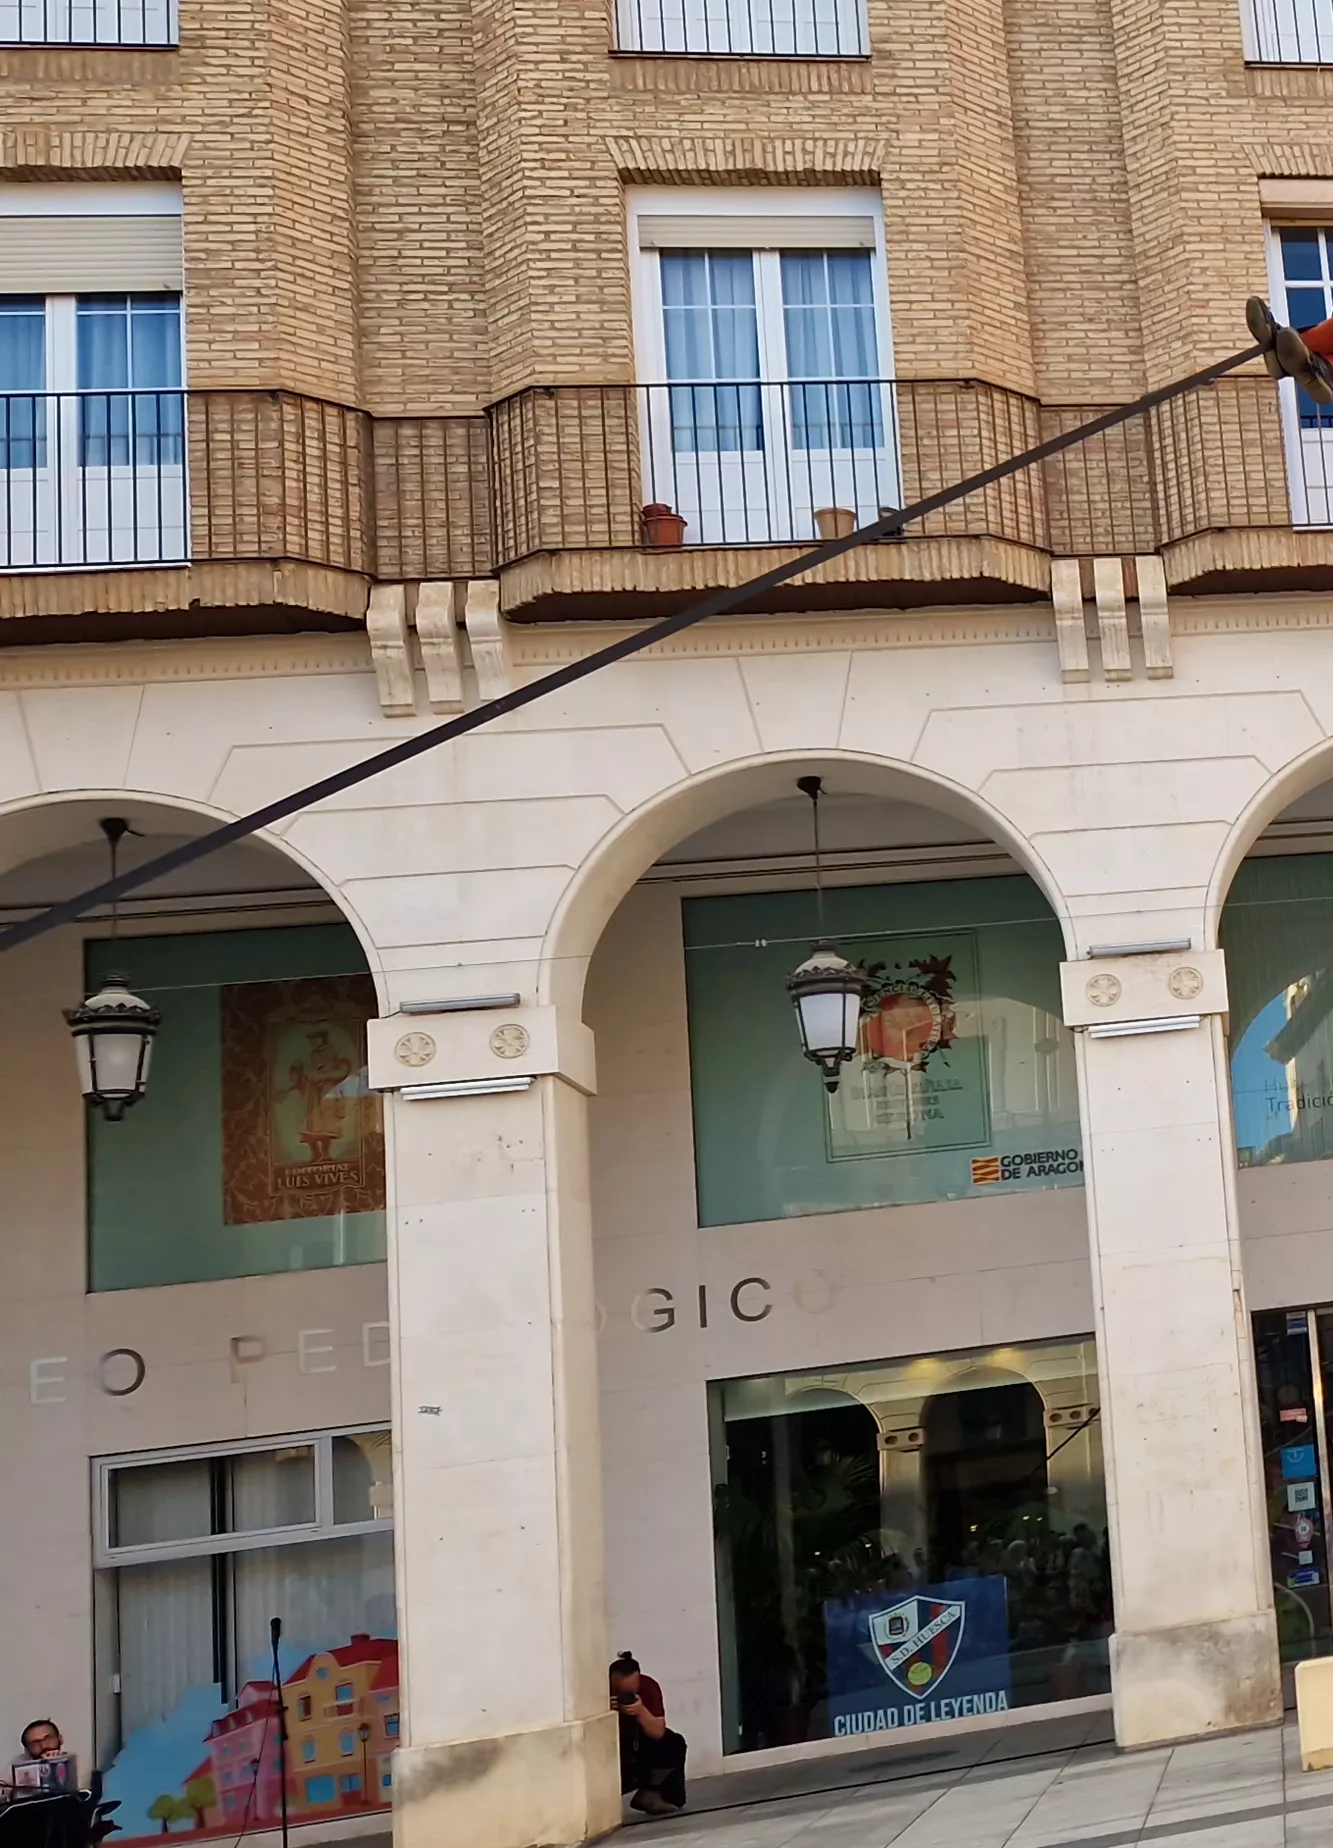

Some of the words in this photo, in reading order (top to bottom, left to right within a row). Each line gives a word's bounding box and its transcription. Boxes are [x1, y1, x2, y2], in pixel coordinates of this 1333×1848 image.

[1000, 1149, 1079, 1167] GOBIERNO
[277, 1174, 310, 1189] LUIS
[315, 1170, 358, 1185] VIVES
[1001, 1168, 1021, 1181] DE
[913, 1611, 956, 1647] HUESCA
[834, 1707, 899, 1736] CIUDAD
[904, 1702, 926, 1726] DE
[930, 1690, 1009, 1722] LEYENDA
